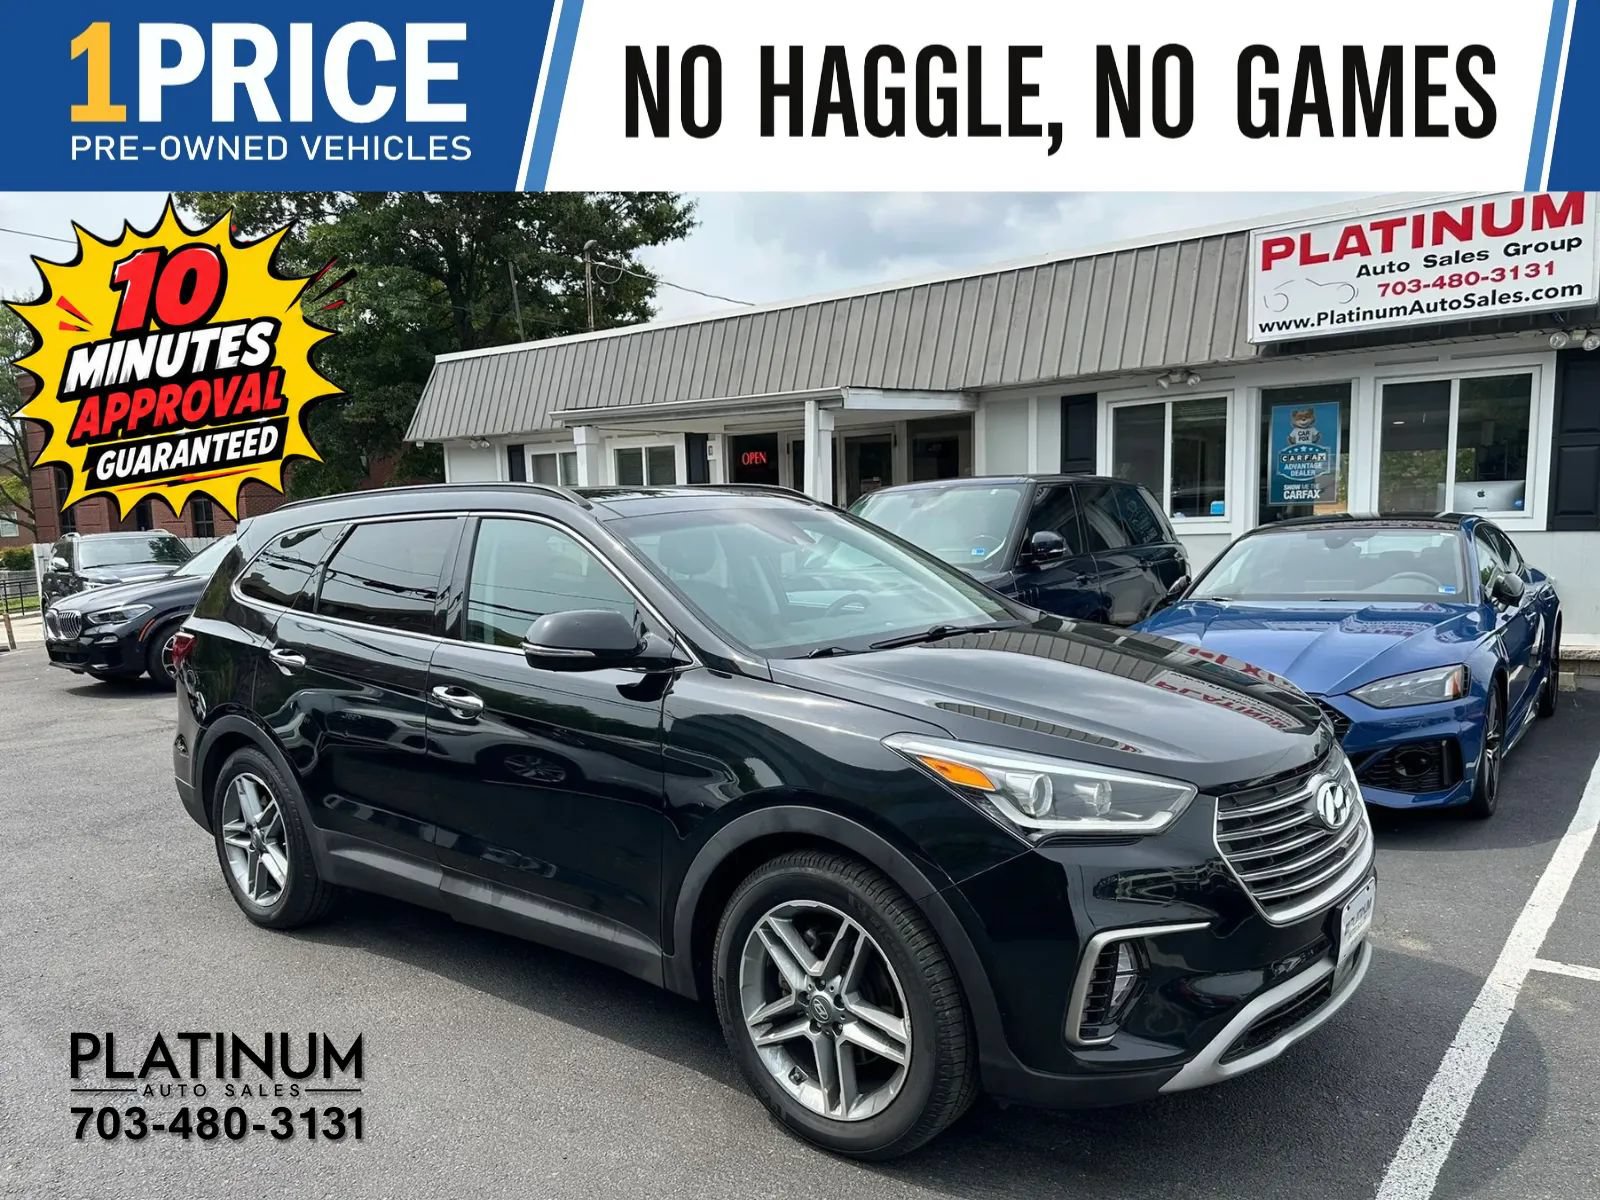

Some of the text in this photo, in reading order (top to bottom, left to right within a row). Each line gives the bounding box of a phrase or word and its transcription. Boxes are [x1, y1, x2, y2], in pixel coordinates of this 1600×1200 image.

[1261, 191, 1585, 272] PLATINUM
[1356, 237, 1583, 278] Auto Sales Group
[1377, 261, 1554, 297] 703-480-3131
[1259, 284, 1583, 333] www.PlatinumAutoSales.com
[742, 452, 767, 465] OPEN
[1282, 454, 1326, 462] CARFAX
[1283, 489, 1321, 500] CARFAX
